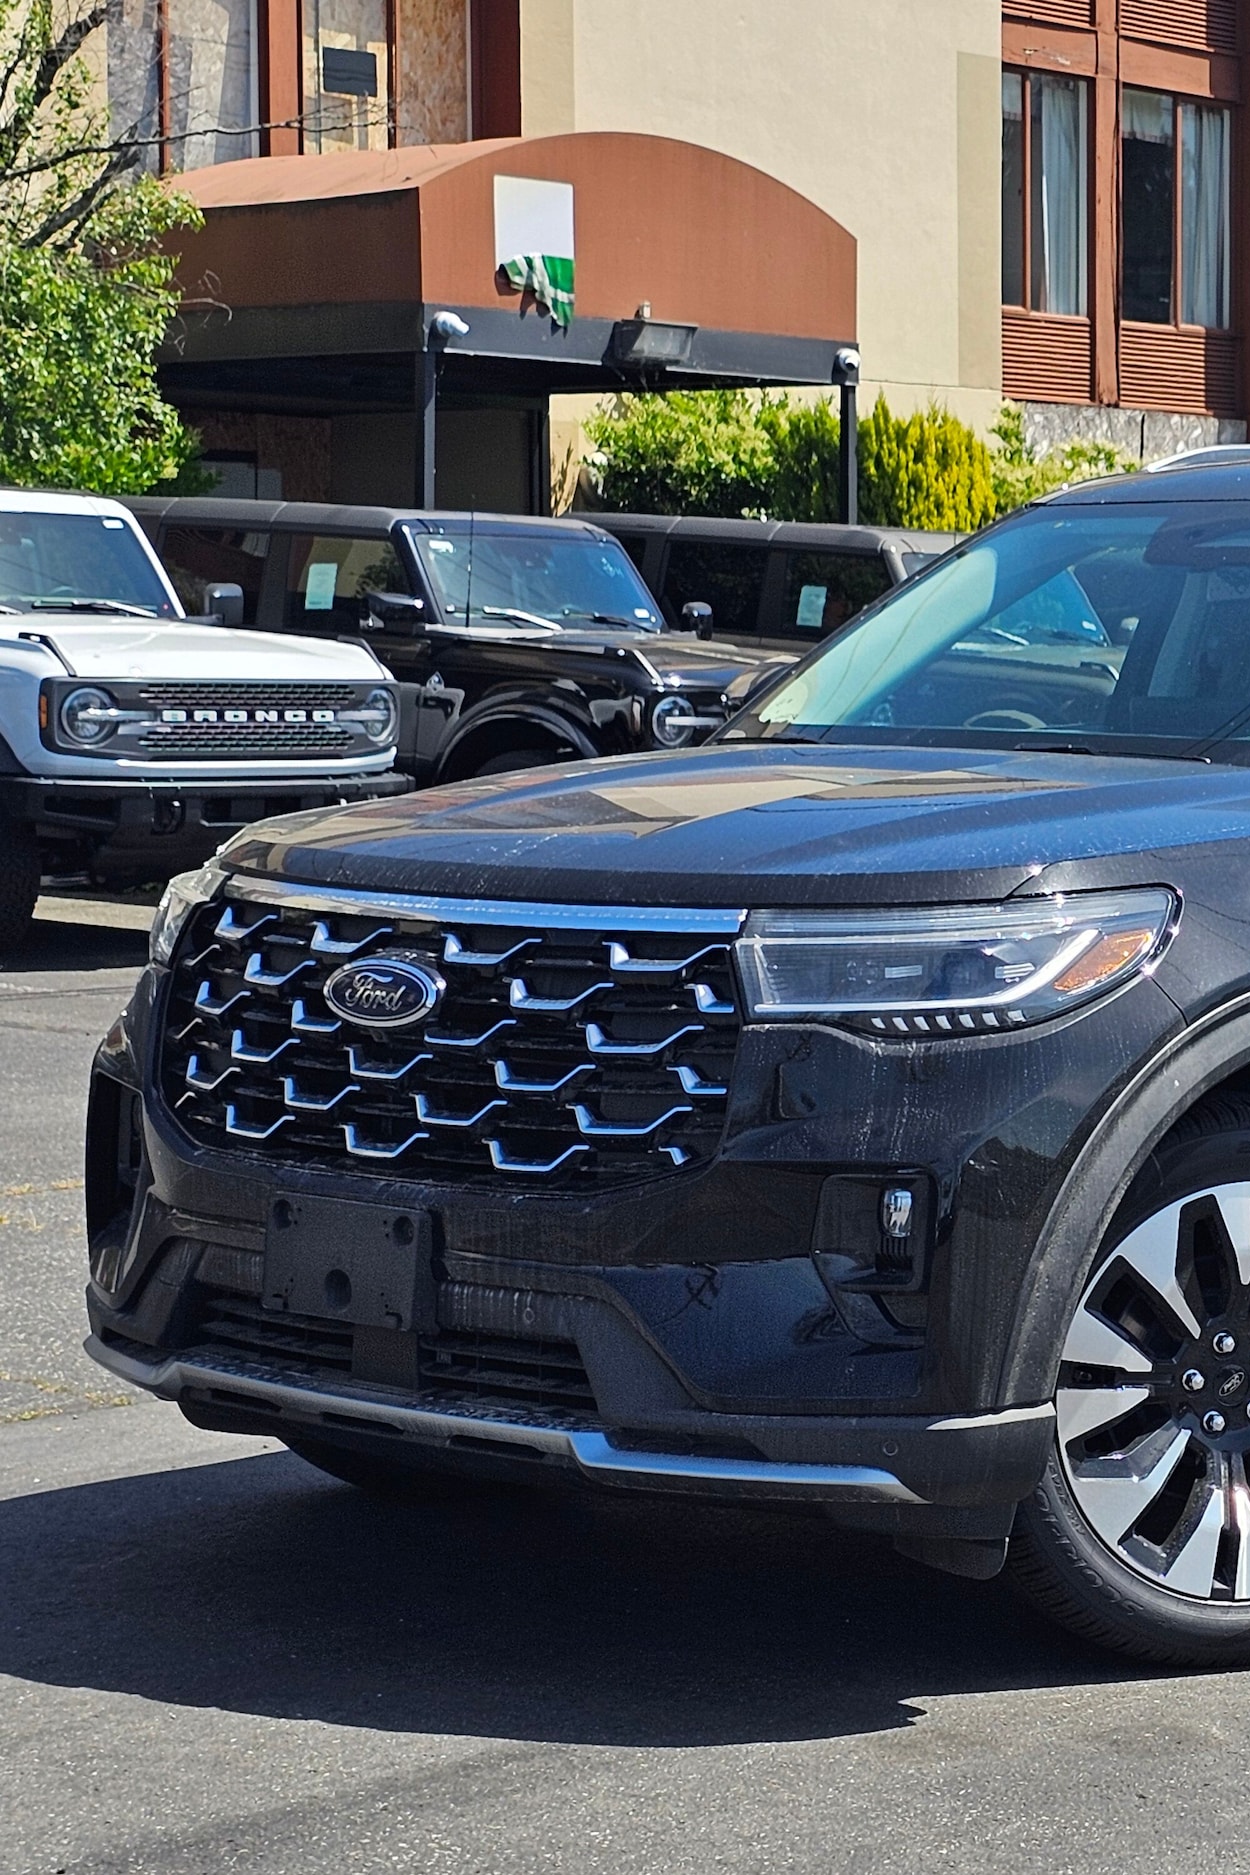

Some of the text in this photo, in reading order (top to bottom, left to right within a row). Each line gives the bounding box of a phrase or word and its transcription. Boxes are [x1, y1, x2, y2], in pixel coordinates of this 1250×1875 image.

[162, 709, 335, 723] BRONCO
[344, 971, 407, 1012] Ford
[1034, 1482, 1145, 1616] SCORPIO
